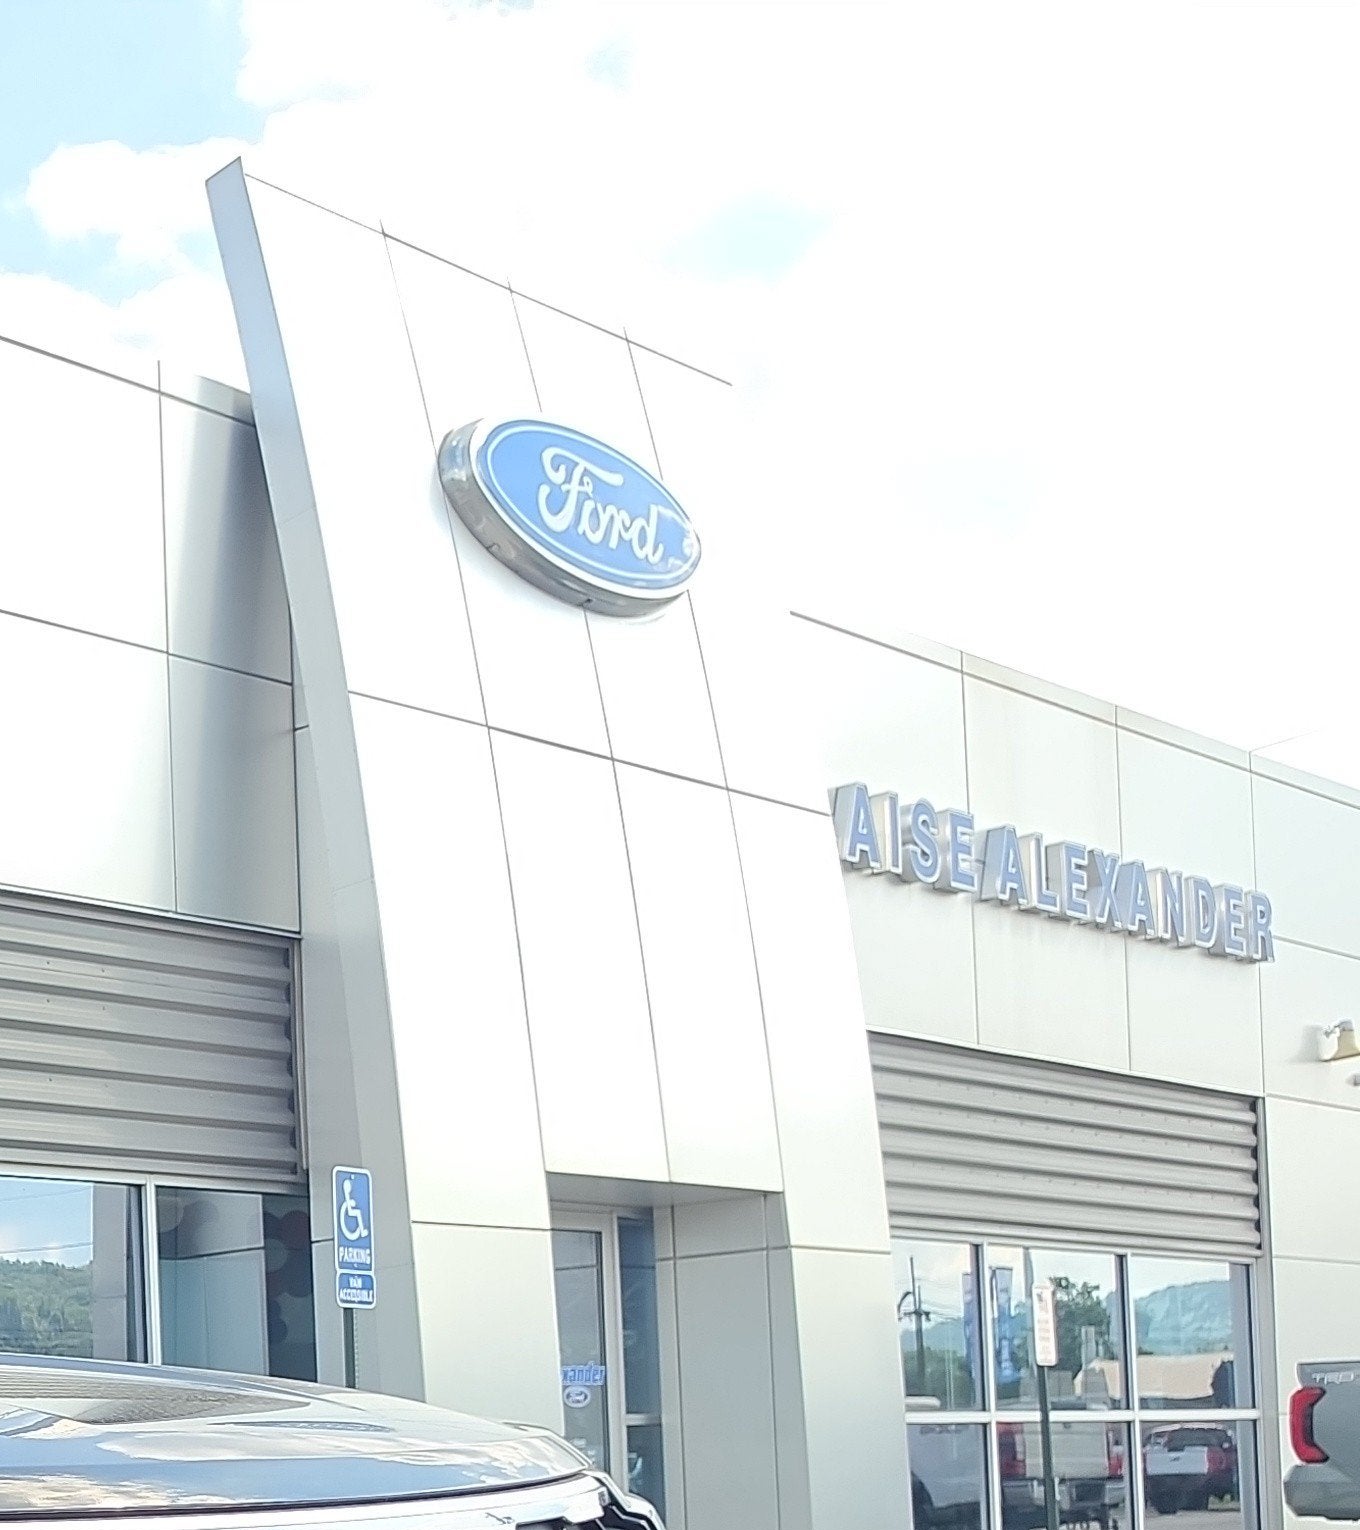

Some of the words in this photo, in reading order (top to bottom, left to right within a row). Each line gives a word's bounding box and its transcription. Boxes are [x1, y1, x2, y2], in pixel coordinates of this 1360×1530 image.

[537, 445, 664, 565] Ford
[988, 824, 1276, 963] ALEXANDER
[339, 1246, 371, 1265] PARKING
[348, 1277, 363, 1289] VAN
